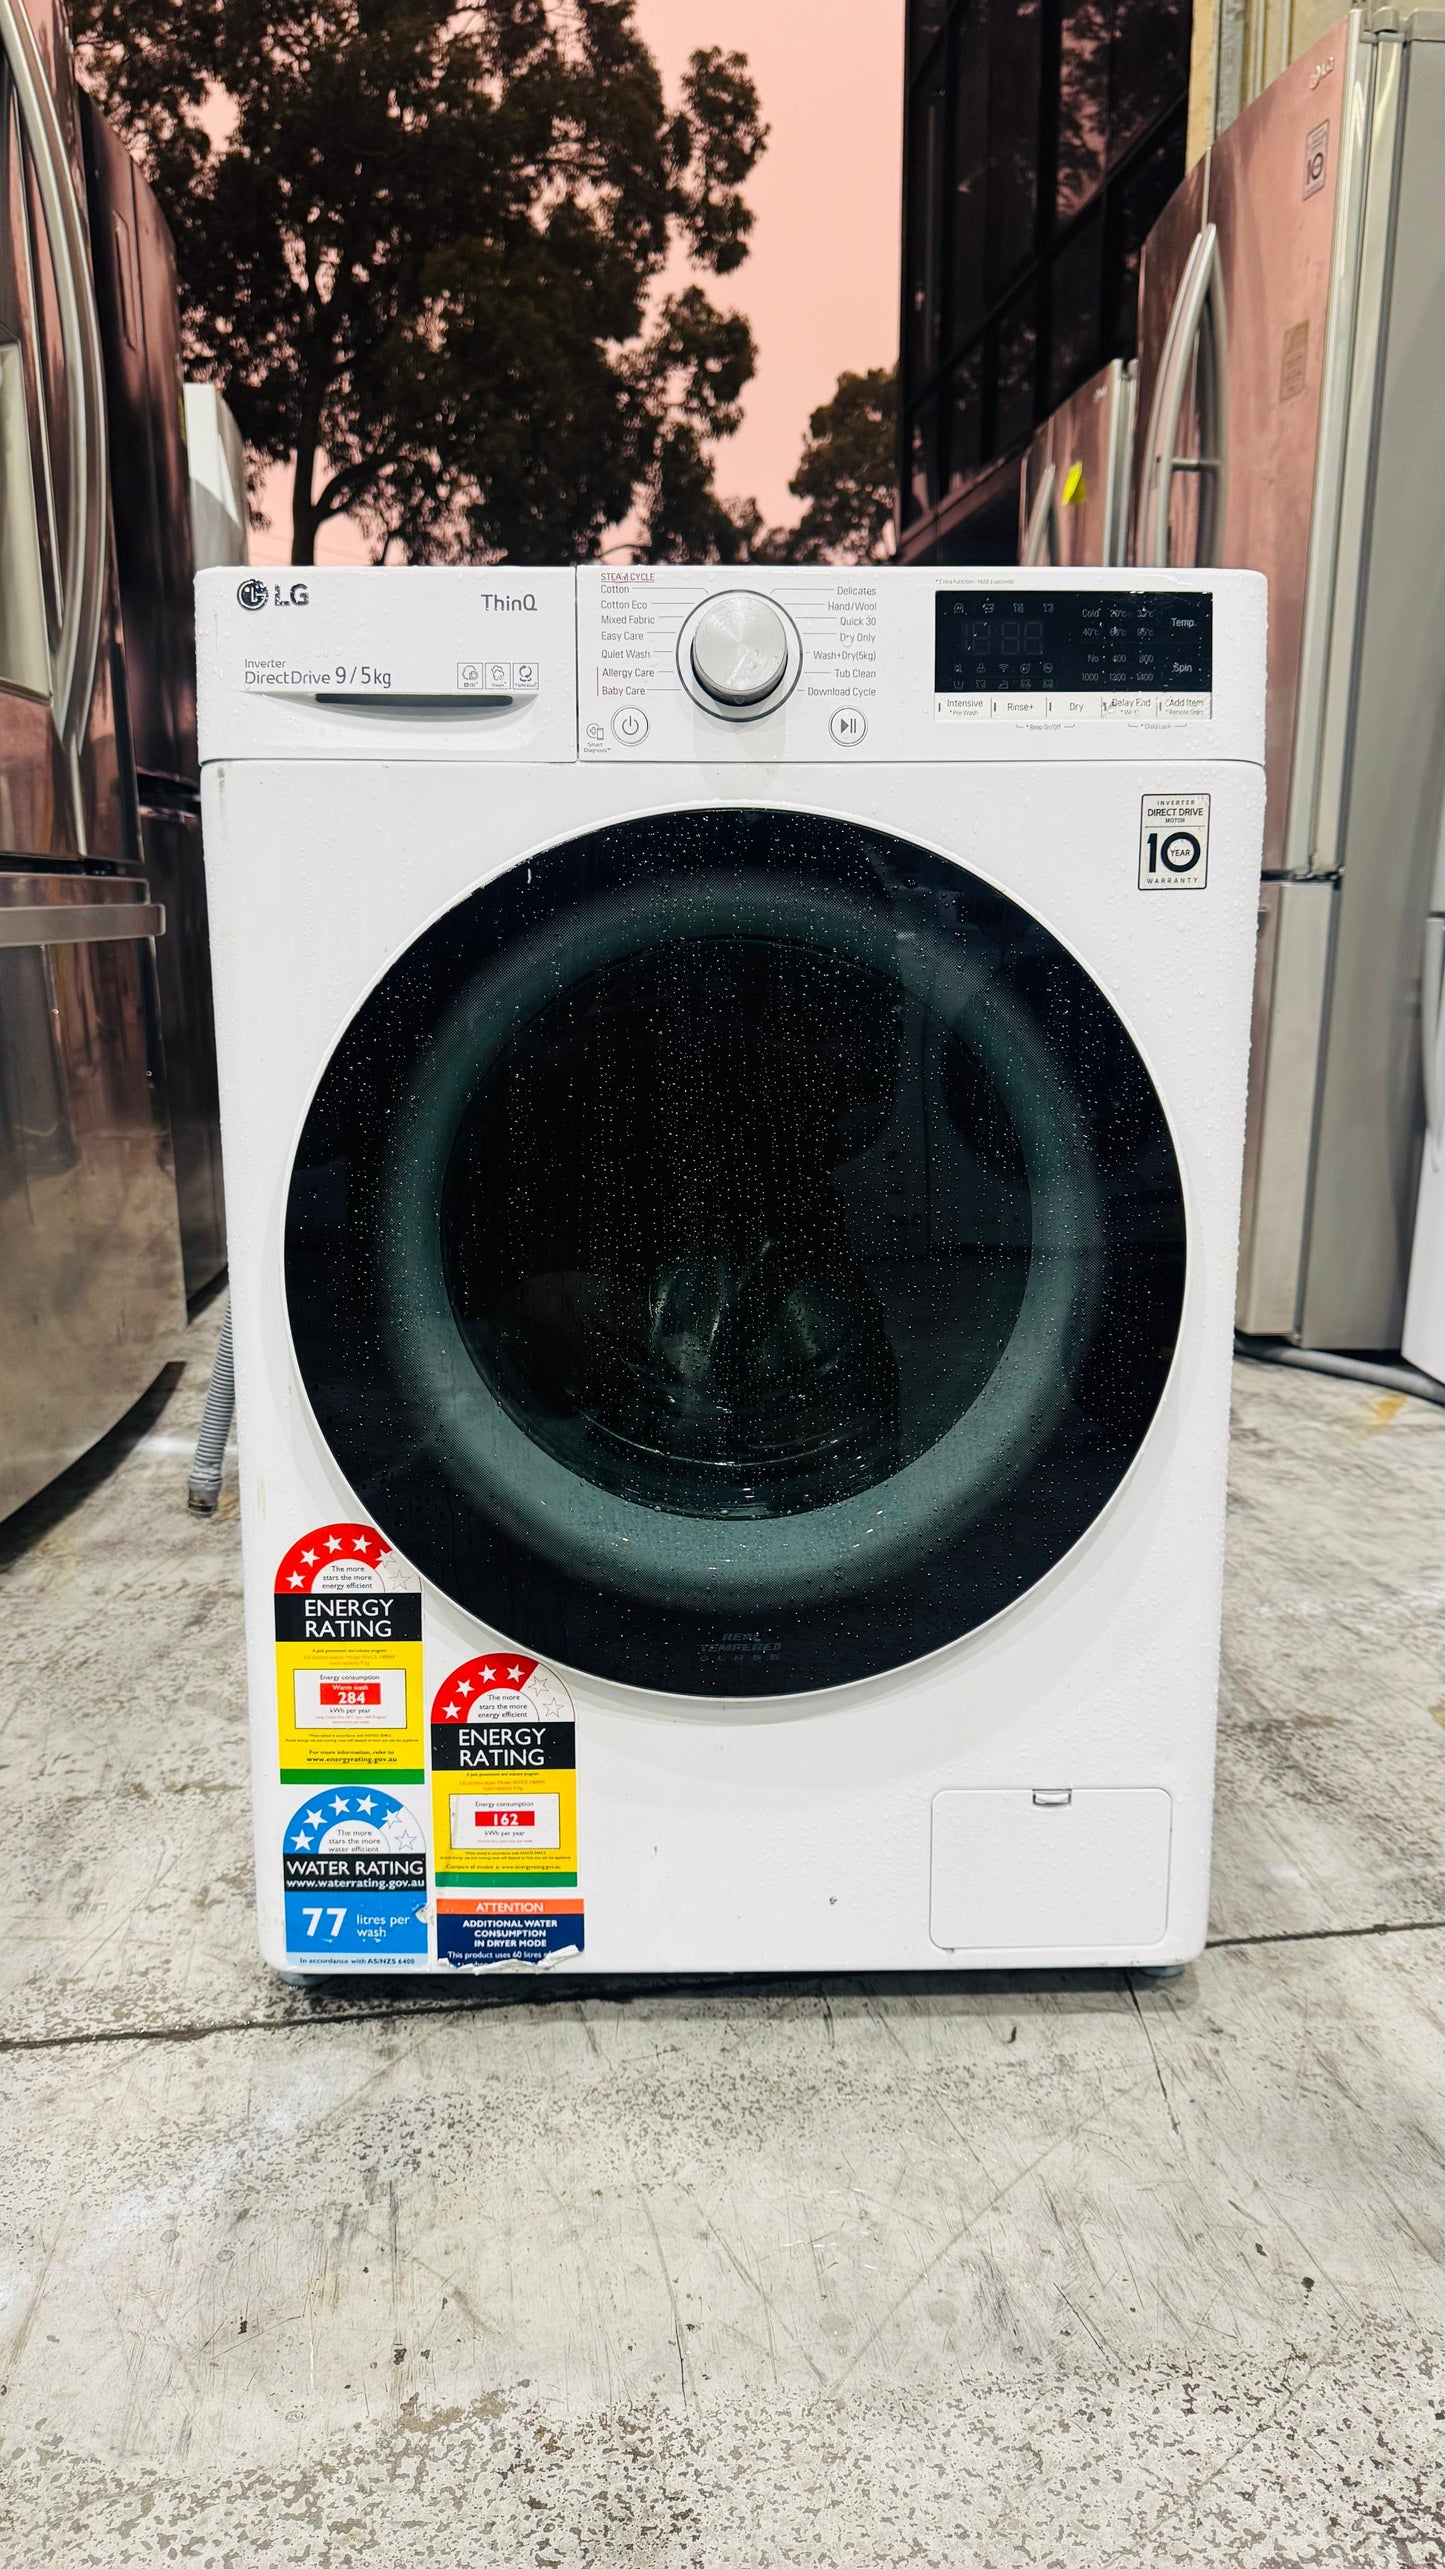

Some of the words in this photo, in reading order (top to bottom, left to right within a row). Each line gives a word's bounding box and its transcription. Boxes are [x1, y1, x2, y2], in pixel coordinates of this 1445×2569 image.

[630, 573, 655, 581] CYCLE
[600, 584, 630, 594] Cotton
[837, 586, 877, 596] Delicates
[274, 583, 309, 606] LG
[480, 594, 538, 611] ThinQ
[600, 600, 630, 609] Cotton
[632, 600, 648, 609] Eco
[828, 601, 877, 611] Hand/Wool
[1082, 608, 1100, 618] Cold
[601, 616, 627, 624] Mixed
[628, 616, 656, 625] Fabric
[840, 617, 864, 626] Quick
[866, 617, 877, 626] 30
[1171, 618, 1197, 629] Temp.
[601, 632, 622, 642] Easy
[624, 632, 644, 641] Care
[840, 633, 855, 643] Dry
[857, 633, 876, 643] Only
[602, 650, 624, 659] Quiet
[626, 650, 651, 659] Wash
[814, 650, 877, 662] Wash+Dry(5kg)
[1088, 655, 1099, 663] No
[1112, 655, 1127, 663] 400
[244, 658, 286, 669] Inverter
[1173, 662, 1193, 673] Spin
[602, 668, 633, 679] Allergy
[634, 668, 655, 677] Care
[834, 669, 850, 678] Tub
[852, 669, 877, 678] Clean
[1082, 673, 1099, 681] 1000
[1109, 673, 1127, 681] 1200
[1136, 673, 1154, 681] 1400
[602, 686, 623, 696] Baby
[626, 686, 646, 696] Care
[808, 687, 851, 696] Download
[852, 687, 877, 698] Cycle
[947, 700, 984, 708] Intensive
[1008, 703, 1035, 711] Rinse+
[1070, 702, 1084, 712] Dry
[1112, 698, 1134, 708] Delay
[1136, 698, 1151, 707] End
[1170, 698, 1185, 707] Add
[1186, 698, 1204, 707] Item
[1148, 808, 1177, 817] DIRECT
[1178, 808, 1204, 816] DRIVE
[1147, 832, 1201, 873] 10
[304, 1599, 394, 1617] ENERGY
[306, 1620, 392, 1638] RATING
[338, 1692, 366, 1704] 284
[478, 1712, 500, 1720] energy
[458, 1728, 546, 1746] ENERGY
[306, 1756, 398, 1764] www.energyrating.gov.au
[460, 1749, 545, 1767] RATING
[493, 1813, 519, 1826] 162
[286, 1860, 351, 1876] WATER
[355, 1860, 424, 1875] RATING
[286, 1878, 425, 1890] www.waterrating.gov.au
[476, 1902, 544, 1913] ATTENTION
[302, 1907, 348, 1937] 77
[356, 1914, 386, 1925] litres
[390, 1917, 411, 1928] per
[462, 1920, 523, 1928] ADDITIONAL
[524, 1920, 558, 1928] WATER
[357, 1927, 387, 1938] wash
[474, 1930, 547, 1938] CONSUMPTION
[474, 1940, 482, 1948] IN
[487, 1940, 517, 1948] DRYER
[519, 1940, 547, 1948] MODE
[447, 1951, 463, 1959] This
[465, 1951, 493, 1960] product
[512, 1951, 522, 1959] 60
